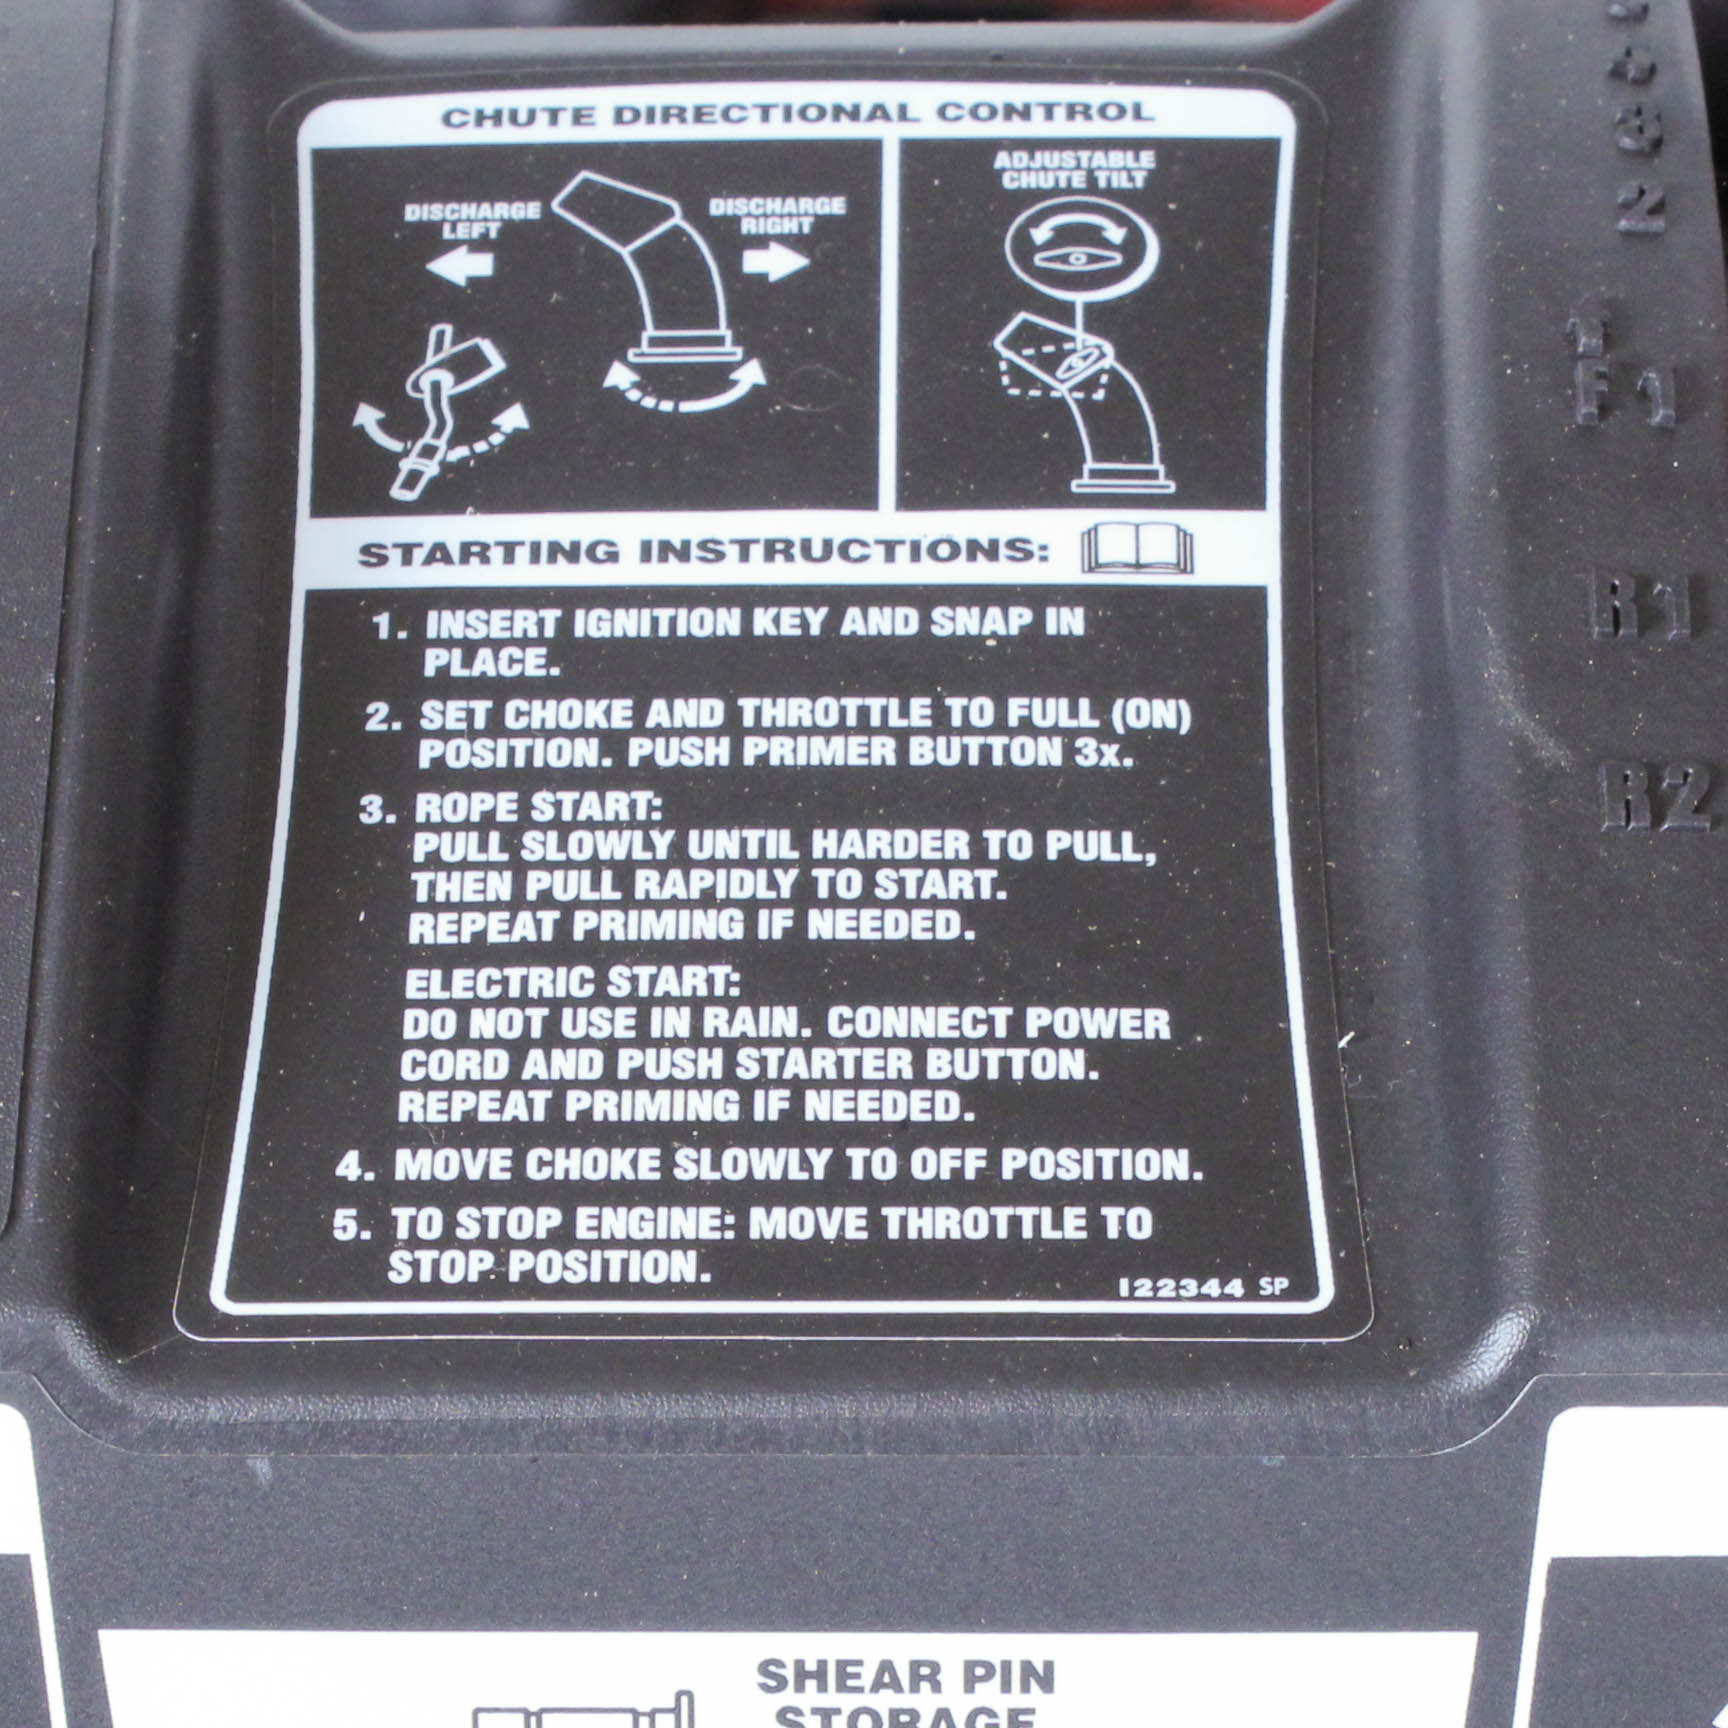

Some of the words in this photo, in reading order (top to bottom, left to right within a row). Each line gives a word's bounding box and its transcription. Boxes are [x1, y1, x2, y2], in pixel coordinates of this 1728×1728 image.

[442, 107, 594, 128] CHUTE
[614, 104, 918, 125] DIRECTIONAL
[937, 102, 1153, 122] CONTROL
[995, 151, 1154, 168] ADJUSTABLE
[1003, 170, 1086, 188] CHUTE
[1095, 170, 1147, 188] TILT
[405, 202, 540, 221] DISCHARGE
[710, 197, 845, 215] DISCHARGE
[1616, 181, 1666, 235] 2
[443, 221, 501, 239] LEFT
[741, 217, 813, 234] RIGHT
[358, 540, 619, 568] STARTING
[640, 538, 1048, 563] INSTRUCTIONS:
[373, 612, 407, 639] 1.
[427, 609, 561, 639] INSERT
[575, 608, 740, 637] IGNITION
[754, 607, 828, 635] KEY
[841, 607, 918, 635] AND
[931, 606, 1032, 636] SNAP
[1047, 607, 1084, 635] IN
[425, 647, 560, 676] PLACE.
[365, 702, 401, 731] 2.
[420, 700, 492, 730] SET
[505, 699, 632, 729] CHOKE
[646, 698, 724, 728] AND
[738, 697, 932, 727] THROTTLE
[945, 697, 994, 727] TO
[1008, 698, 1099, 727] FULL
[1112, 698, 1191, 734] (ON)
[420, 737, 612, 768] POSITION.
[629, 736, 729, 766] PUSH
[744, 736, 895, 765] PRIMER
[910, 736, 1062, 766] BUTTON
[1075, 737, 1133, 767] 3x.
[360, 794, 396, 824] 3.
[416, 792, 518, 822] ROPE
[531, 790, 661, 821] START:
[414, 831, 509, 862] PULL
[521, 830, 675, 861] SLOWLY
[689, 829, 799, 859] UNTIL
[813, 829, 969, 859] HARDER
[983, 829, 1032, 860] TO
[1047, 830, 1156, 866] PULL,
[411, 871, 511, 902] THEN
[527, 870, 621, 901] PULL
[635, 869, 799, 899] RAPIDLY
[812, 868, 862, 899] TO
[875, 868, 1006, 899] START.
[409, 911, 560, 944] REPEAT
[574, 908, 743, 940] PRIMING
[758, 909, 794, 939] IF
[808, 909, 974, 939] NEEDED.
[406, 966, 594, 999] ELECTRIC
[607, 965, 740, 997] START:
[403, 1008, 456, 1039] DO
[470, 1008, 549, 1039] NOT
[562, 1007, 636, 1038] USE
[651, 1007, 690, 1037] IN
[704, 1006, 811, 1037] RAIN.
[828, 1006, 1013, 1038] CONNECT
[1027, 1007, 1170, 1039] POWER
[401, 1049, 509, 1081] CORD
[522, 1049, 603, 1079] AND
[618, 1048, 722, 1080] PUSH
[736, 1047, 912, 1079] STARTER
[927, 1048, 1098, 1080] BUTTON.
[399, 1090, 552, 1122] REPEAT
[566, 1089, 739, 1121] PRIMING
[754, 1089, 790, 1121] IF
[805, 1090, 974, 1121] NEEDED.
[336, 1150, 374, 1181] 4.
[395, 1148, 512, 1180] MOVE
[527, 1148, 660, 1180] CHOKE
[674, 1148, 833, 1180] SLOWLY
[846, 1148, 897, 1180] TO
[911, 1148, 987, 1180] OFF
[1002, 1148, 1202, 1180] POSITION.
[333, 1209, 371, 1240] 5.
[392, 1207, 443, 1240] TO
[456, 1207, 562, 1239] STOP
[576, 1207, 734, 1239] ENGINE:
[750, 1207, 868, 1239] MOVE
[881, 1207, 1087, 1239] THROTTLE
[1101, 1207, 1152, 1239] TO
[388, 1250, 495, 1283] STOP
[509, 1249, 710, 1283] POSITION.
[1259, 1277, 1289, 1295] SP
[758, 1658, 941, 1694] SHEAR
[964, 1660, 1054, 1694] PIN
